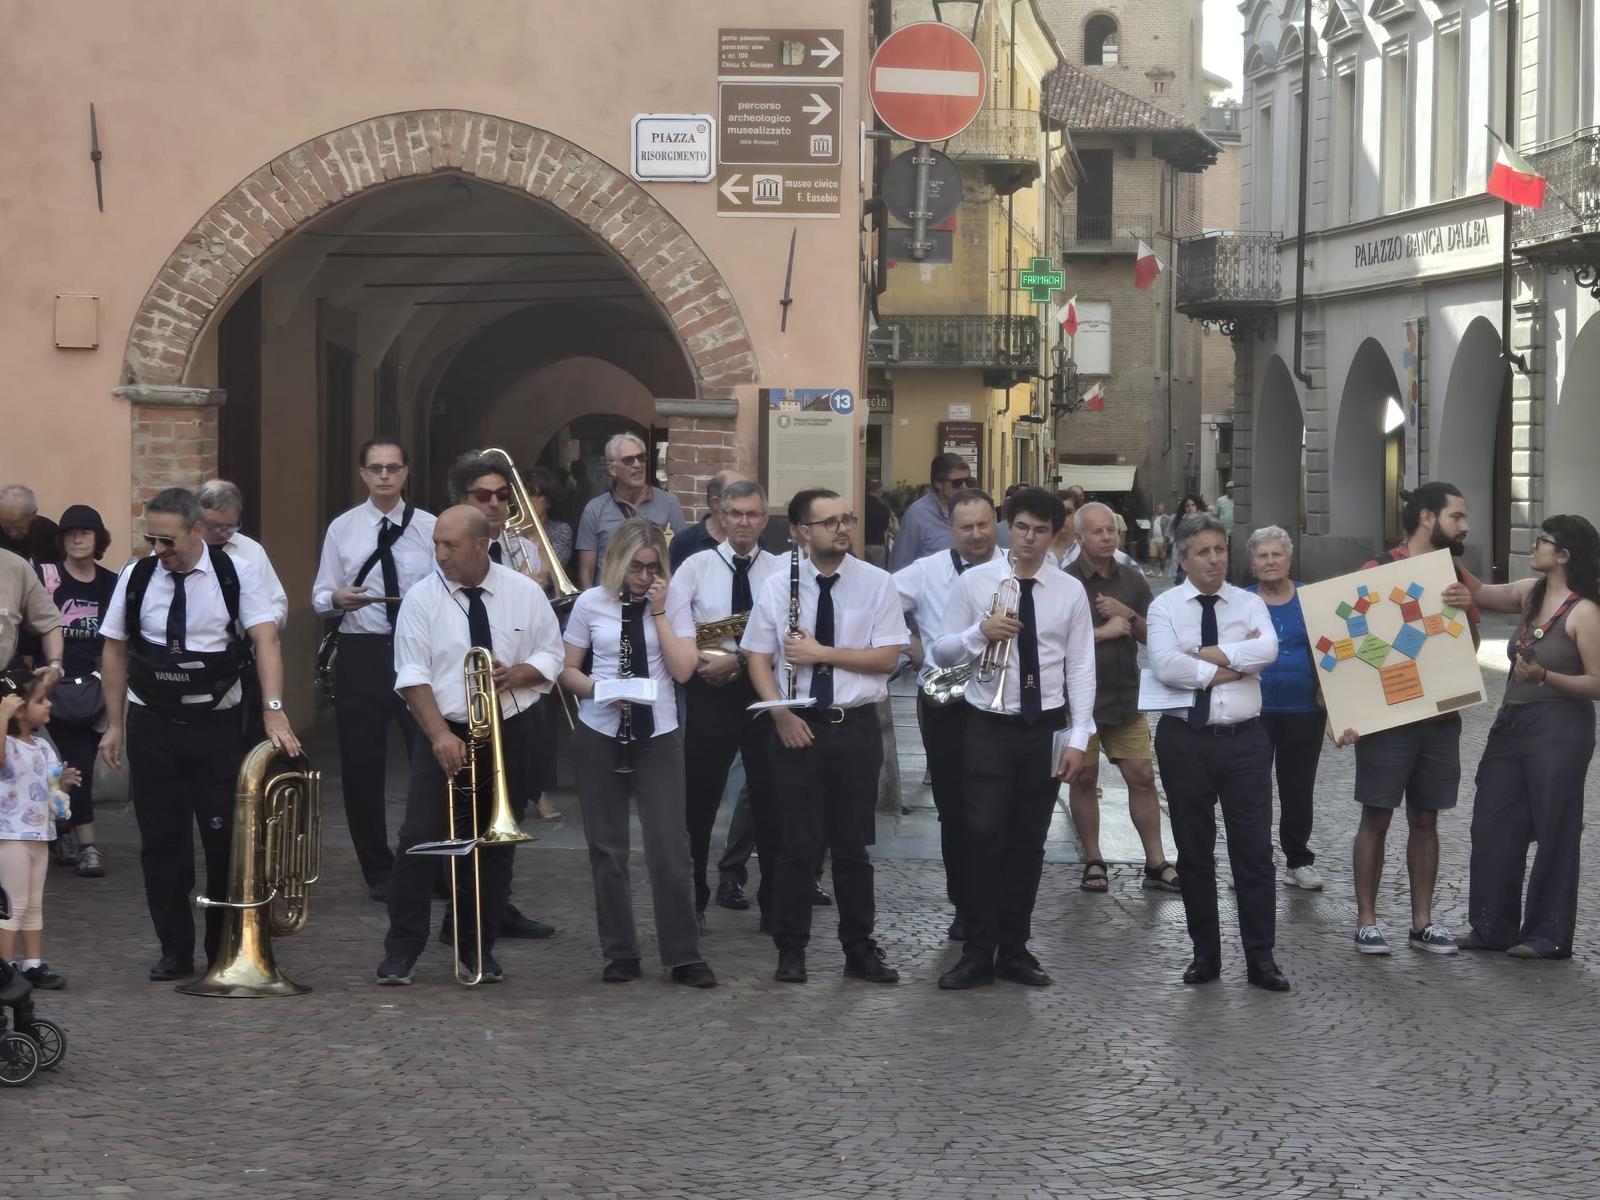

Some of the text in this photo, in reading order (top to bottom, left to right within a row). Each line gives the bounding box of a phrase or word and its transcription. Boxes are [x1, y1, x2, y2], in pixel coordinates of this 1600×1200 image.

[738, 102, 781, 110] percorso
[728, 113, 791, 124] archeologico
[727, 126, 792, 135] musealizzato
[651, 132, 696, 143] PIAZZA
[641, 150, 707, 161] RISORGIMENTO
[785, 178, 839, 188] museo civico
[806, 192, 838, 202] Eusebio
[1354, 217, 1490, 268] PALAZZO BANCA D'ALBA
[1022, 275, 1060, 285] FARMACIA
[834, 394, 851, 409] 13
[154, 671, 191, 682] YAMAHA
